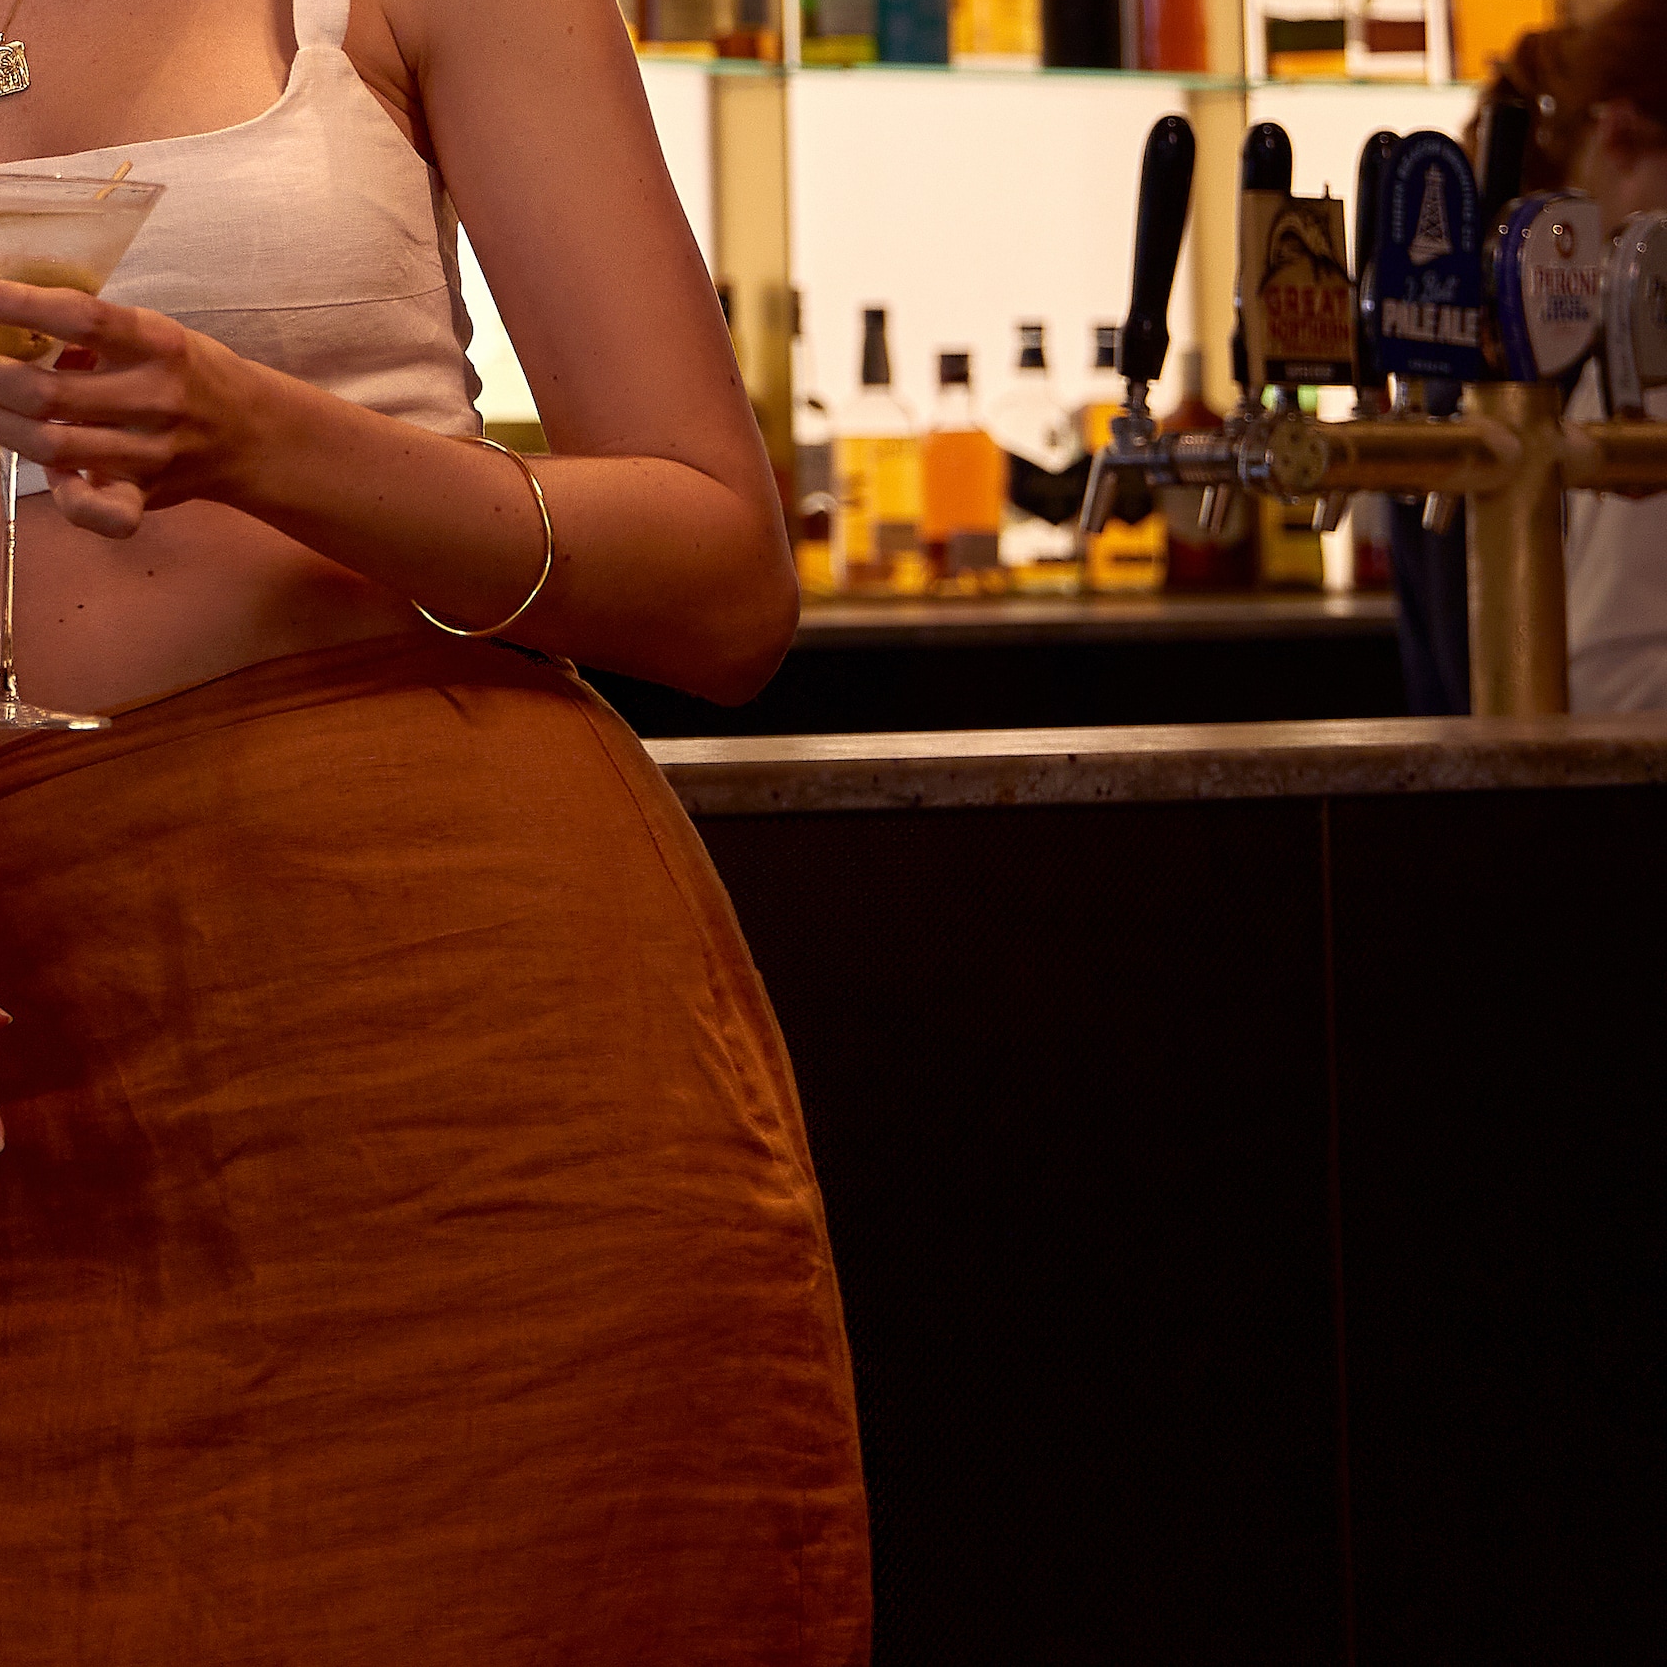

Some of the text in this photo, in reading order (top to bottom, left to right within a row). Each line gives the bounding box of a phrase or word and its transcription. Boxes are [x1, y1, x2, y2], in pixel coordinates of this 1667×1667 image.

[1533, 264, 1598, 296] PERONI
[1264, 284, 1348, 319] GREAT
[1382, 298, 1479, 347] PALE ALE
